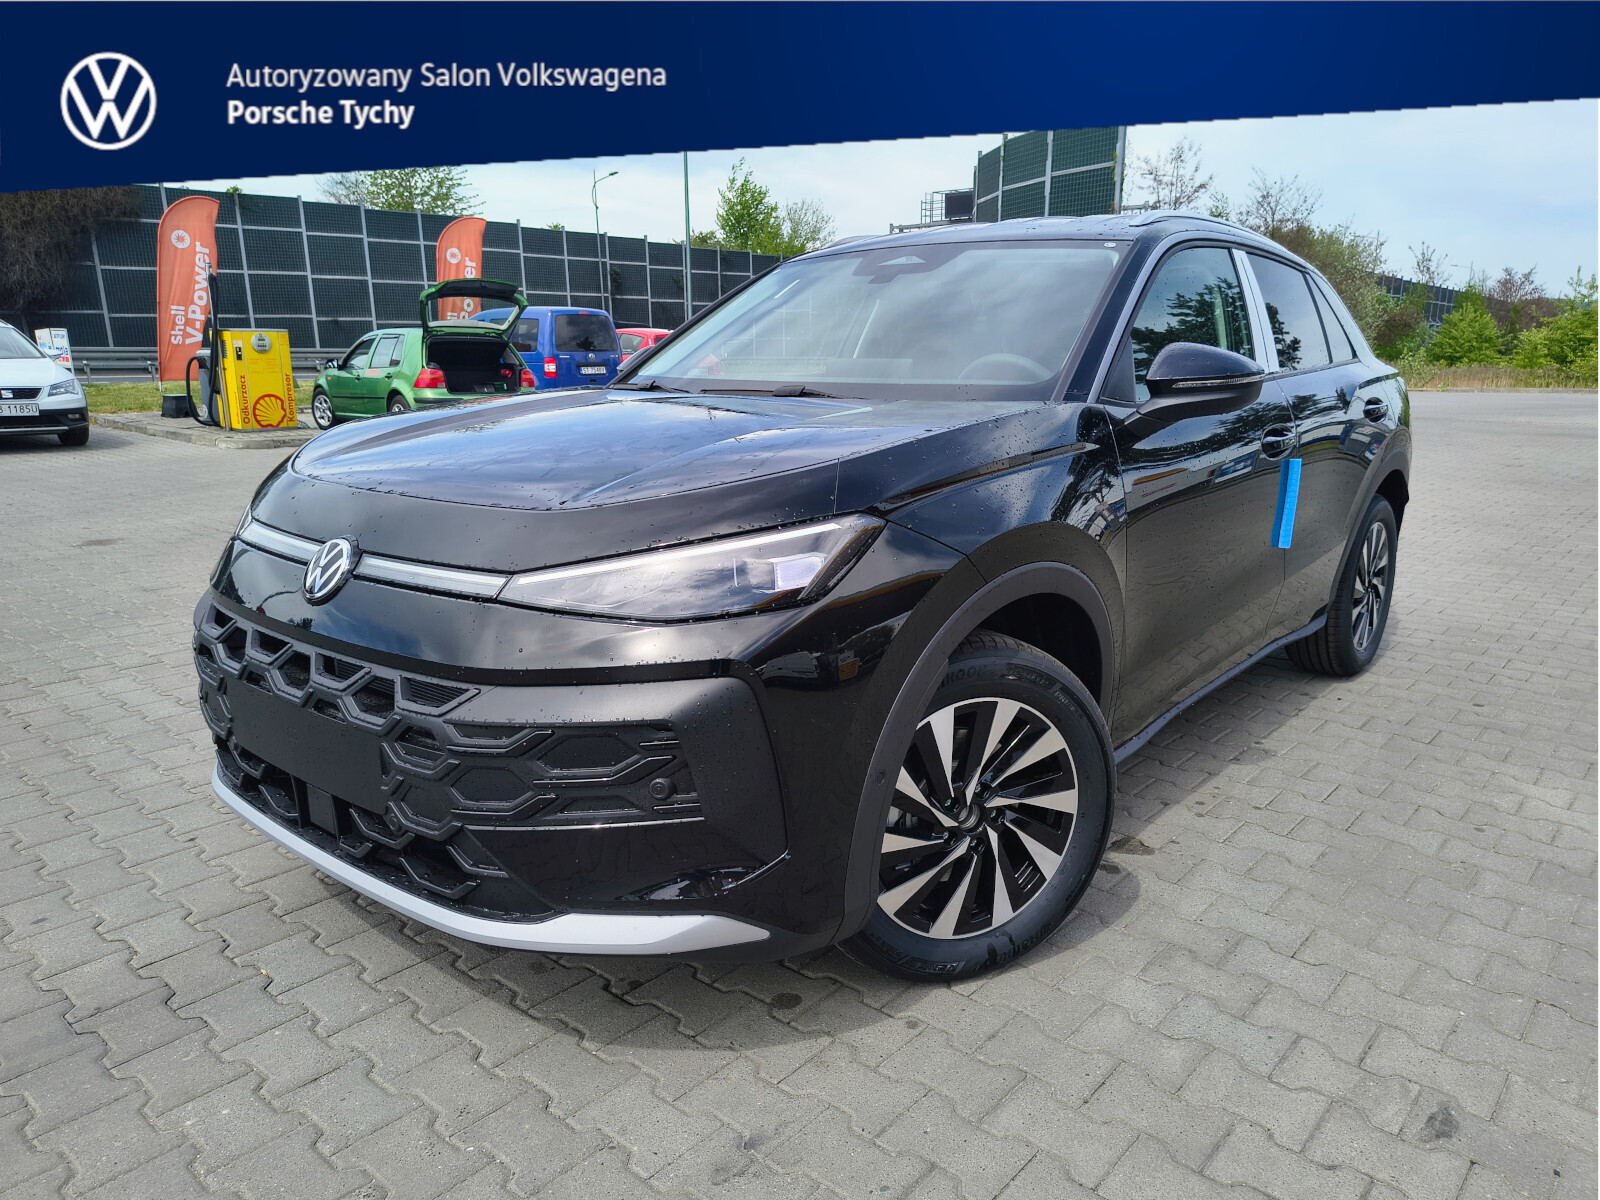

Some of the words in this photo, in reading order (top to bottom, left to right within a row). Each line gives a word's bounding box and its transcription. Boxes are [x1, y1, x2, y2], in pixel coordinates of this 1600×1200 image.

[185, 241, 210, 345] V-Power
[170, 305, 186, 345] Shell
[8, 404, 38, 414] 1185U
[239, 374, 251, 425] Odkurzacz
[285, 373, 296, 423] Kompresor
